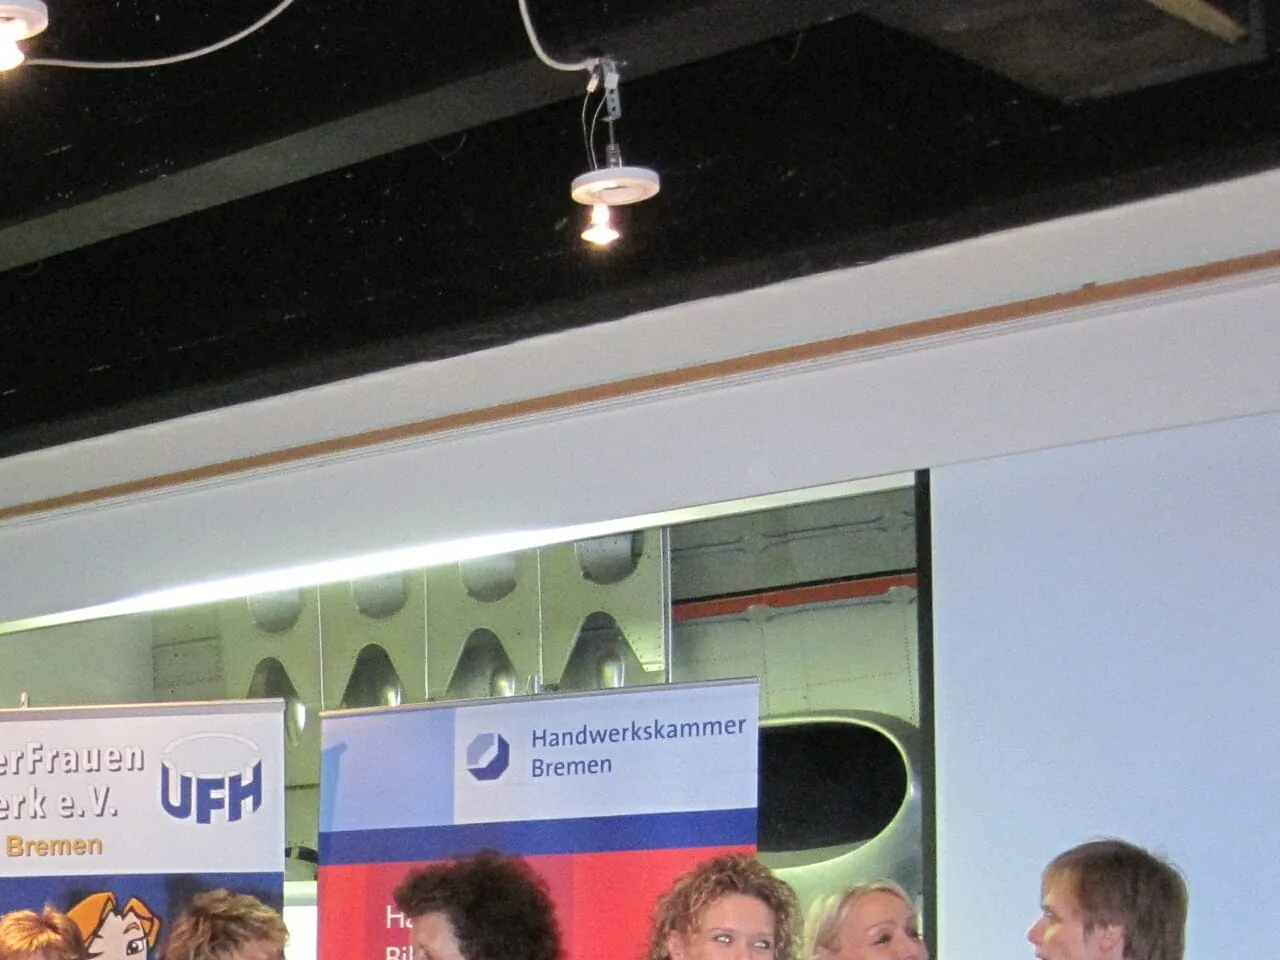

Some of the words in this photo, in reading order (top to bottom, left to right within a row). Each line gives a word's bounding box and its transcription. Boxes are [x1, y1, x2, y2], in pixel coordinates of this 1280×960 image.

[532, 718, 746, 748] Handwerkskammer
[532, 758, 612, 778] Bremen
[57, 784, 119, 819] e.V.
[161, 757, 263, 824] UFH
[5, 834, 103, 858] Bremen
